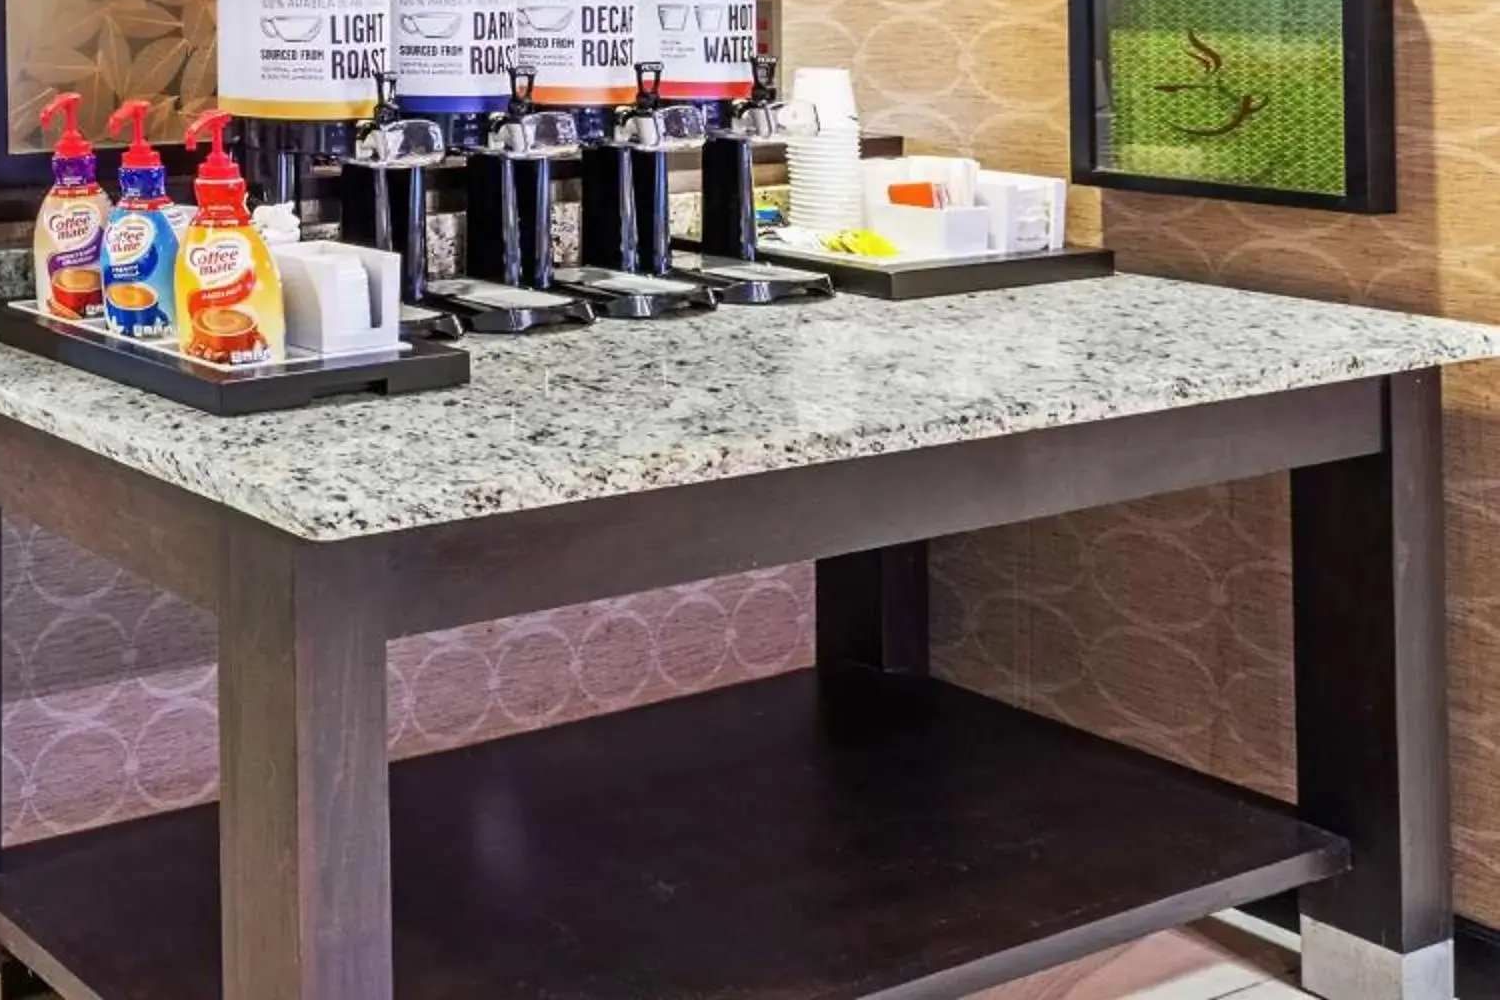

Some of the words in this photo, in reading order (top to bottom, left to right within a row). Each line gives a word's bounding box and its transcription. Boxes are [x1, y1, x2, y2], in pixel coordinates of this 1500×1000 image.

[473, 11, 514, 40] DARK
[581, 5, 634, 34] DECAF
[728, 3, 753, 31] HOT
[330, 13, 385, 44] LIGHT
[400, 45, 438, 56] SOURCED
[440, 45, 463, 56] FROM
[518, 37, 549, 48] OURCED
[551, 37, 575, 48] FROM
[581, 38, 634, 67] ROAST
[260, 49, 298, 60] SOURCED
[300, 49, 325, 60] FROM
[331, 48, 387, 80] ROAST
[50, 214, 91, 232] Coffee
[57, 226, 89, 240] mate
[189, 247, 239, 268] Coffee
[199, 261, 237, 277] mate
